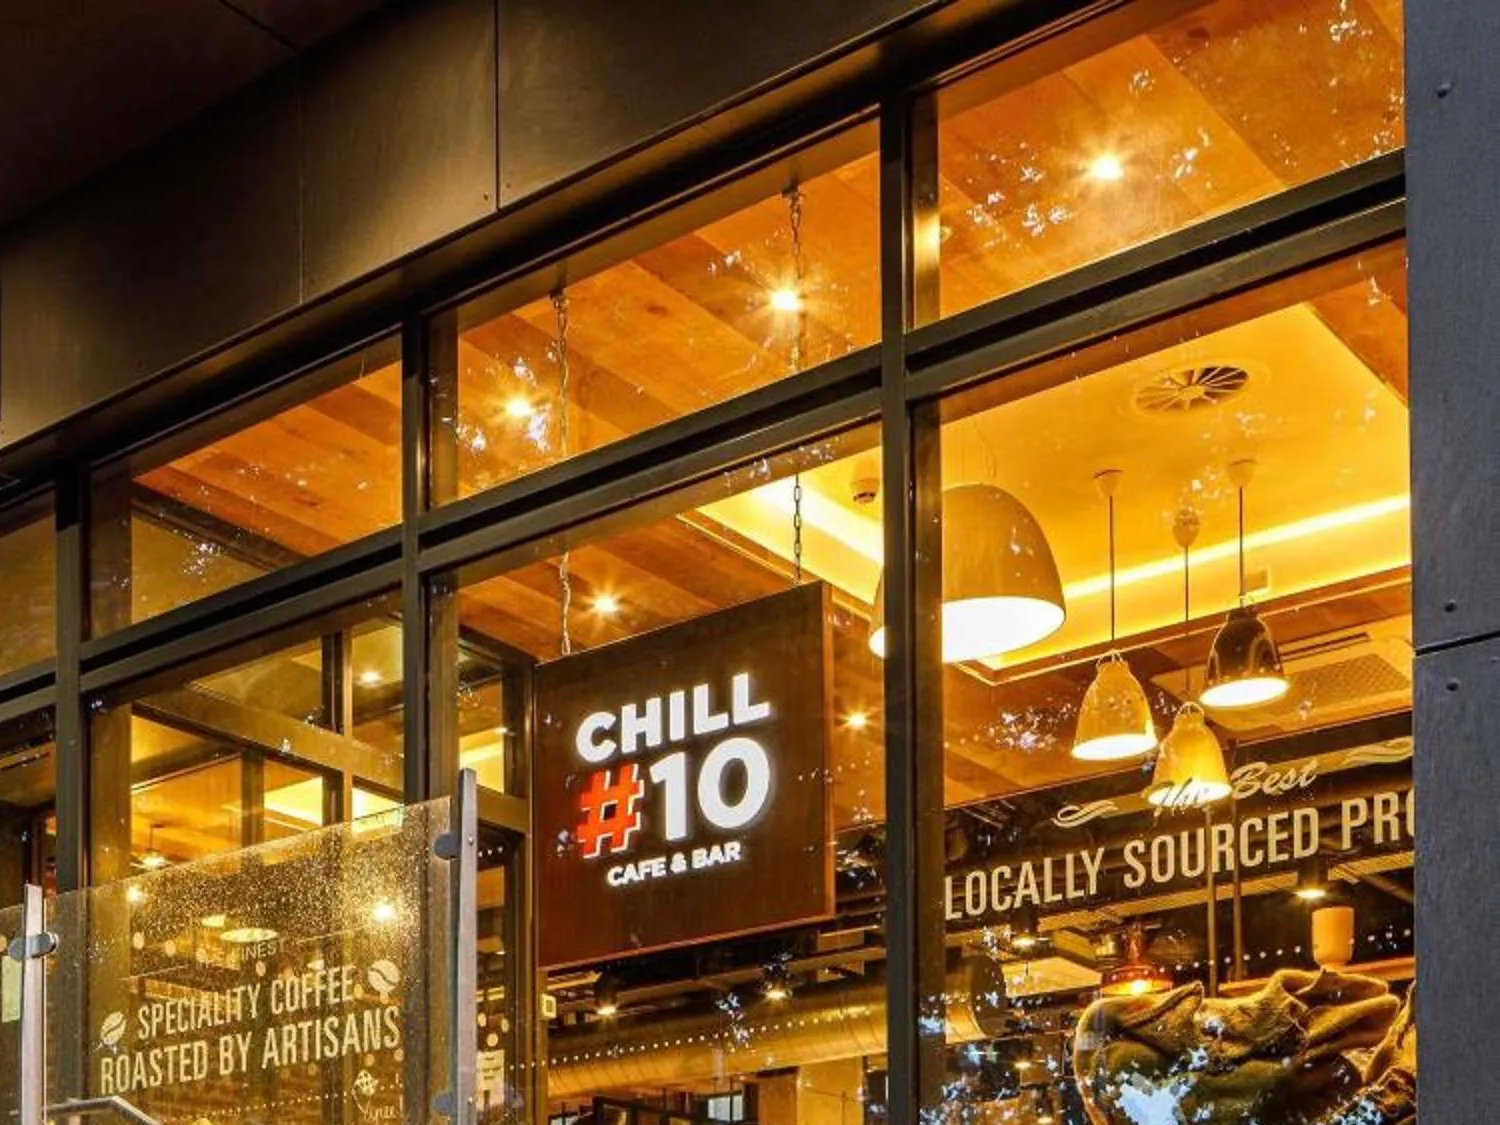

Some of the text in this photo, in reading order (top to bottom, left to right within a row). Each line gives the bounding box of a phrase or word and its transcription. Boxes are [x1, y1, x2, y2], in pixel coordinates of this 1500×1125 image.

[575, 673, 771, 763] CHILL
[576, 737, 771, 858] #10
[1230, 760, 1320, 799] Best
[607, 842, 741, 886] CAFE & BAR
[944, 847, 1106, 921] LOCALLY
[1123, 807, 1319, 889] SOURCED
[138, 965, 356, 1040] SPECIALITY COFFEE
[101, 1005, 400, 1094] ROASTED BY ARTISANS
